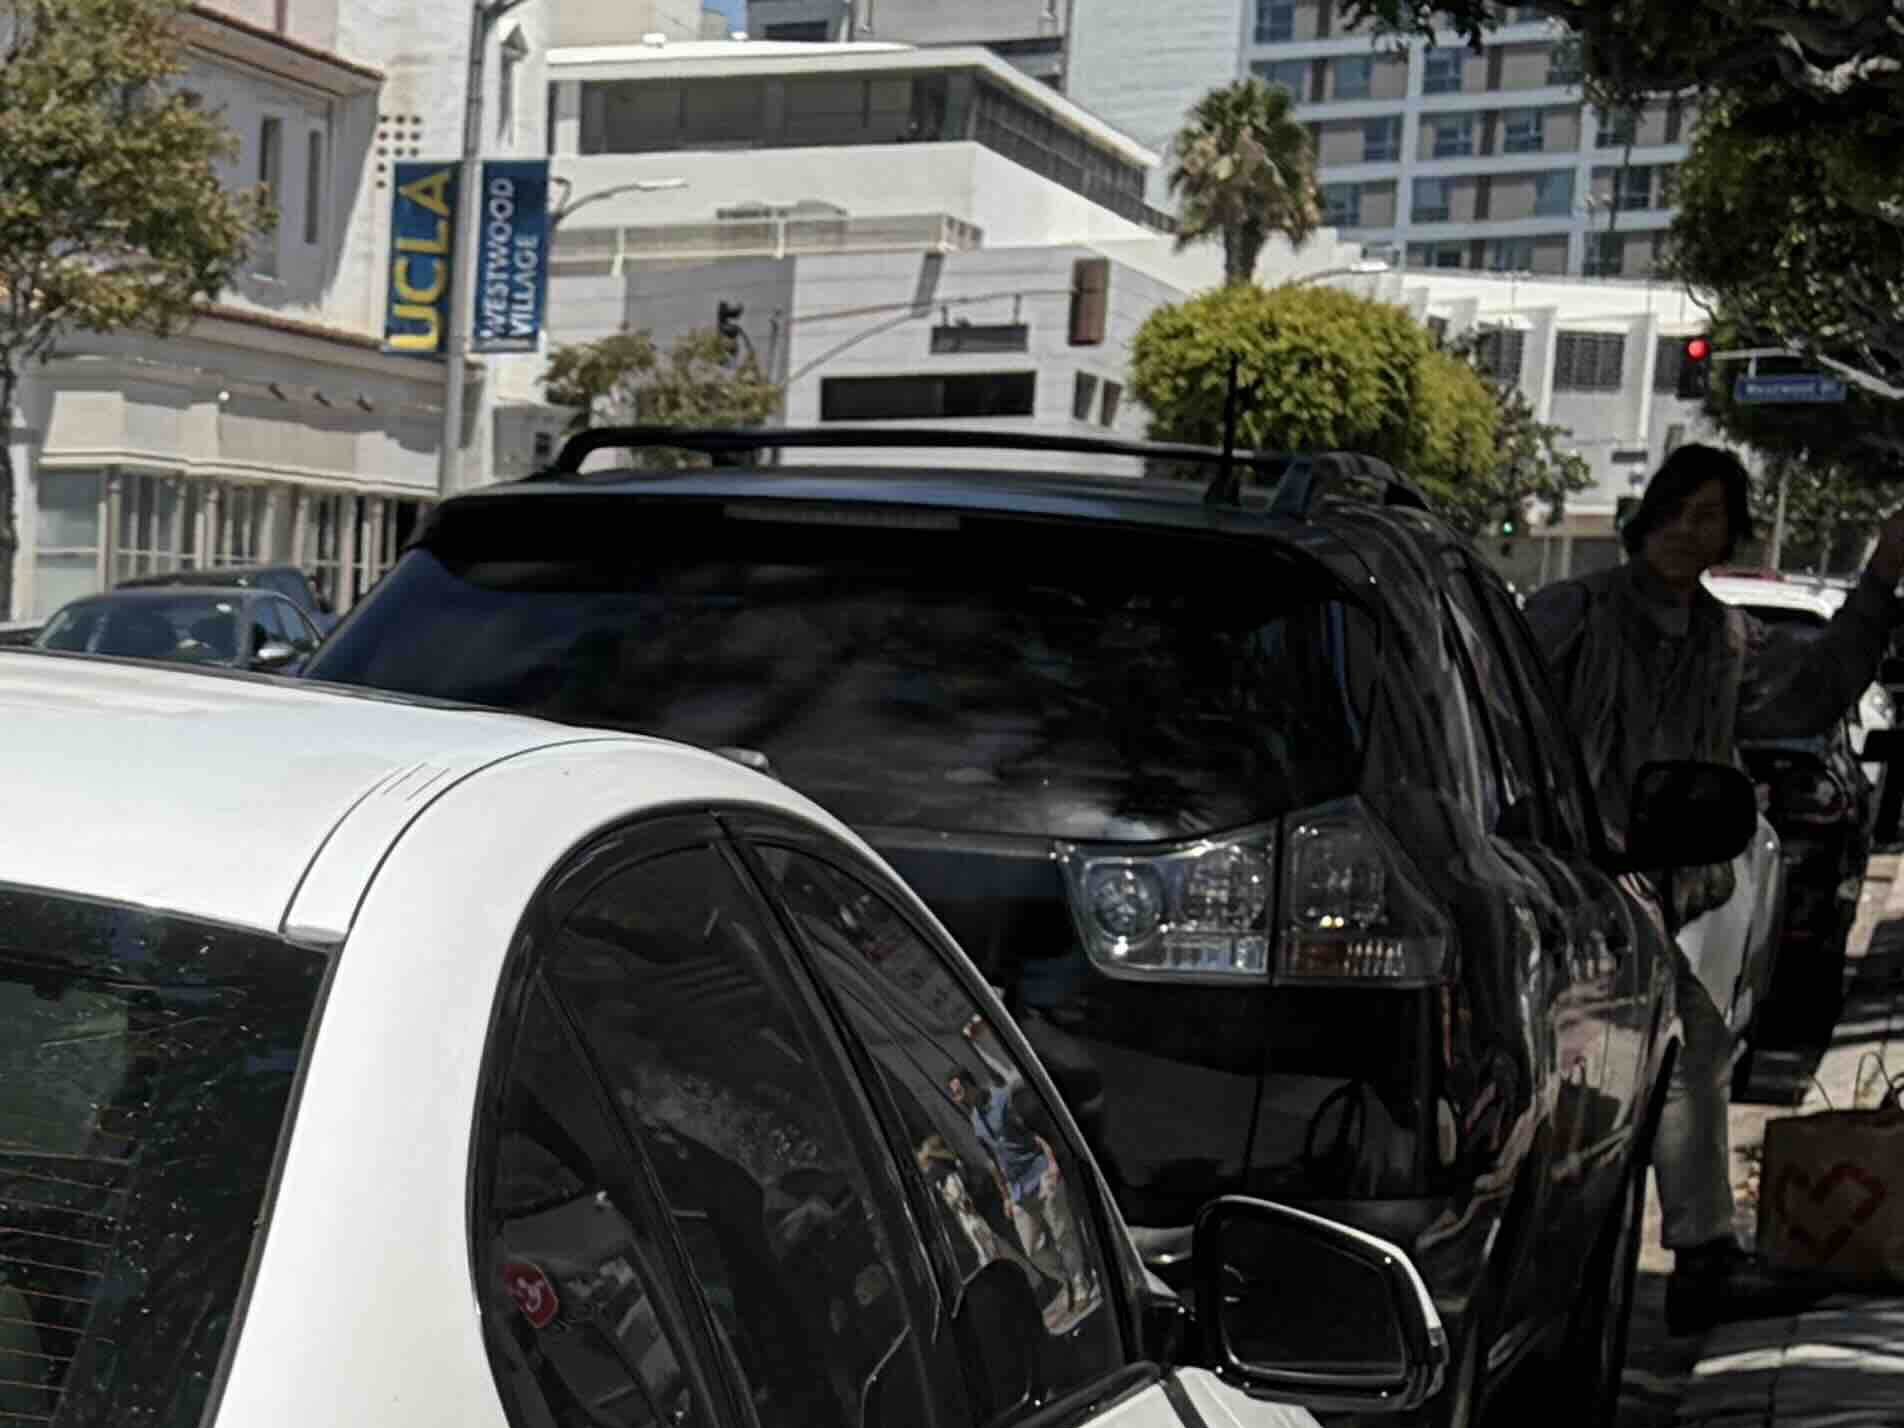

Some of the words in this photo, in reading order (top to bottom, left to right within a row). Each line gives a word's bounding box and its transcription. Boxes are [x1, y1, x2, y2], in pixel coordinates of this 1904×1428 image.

[389, 171, 450, 350] UCLA
[480, 177, 515, 337] WESTWOOD
[509, 233, 540, 337] VILLAGE
